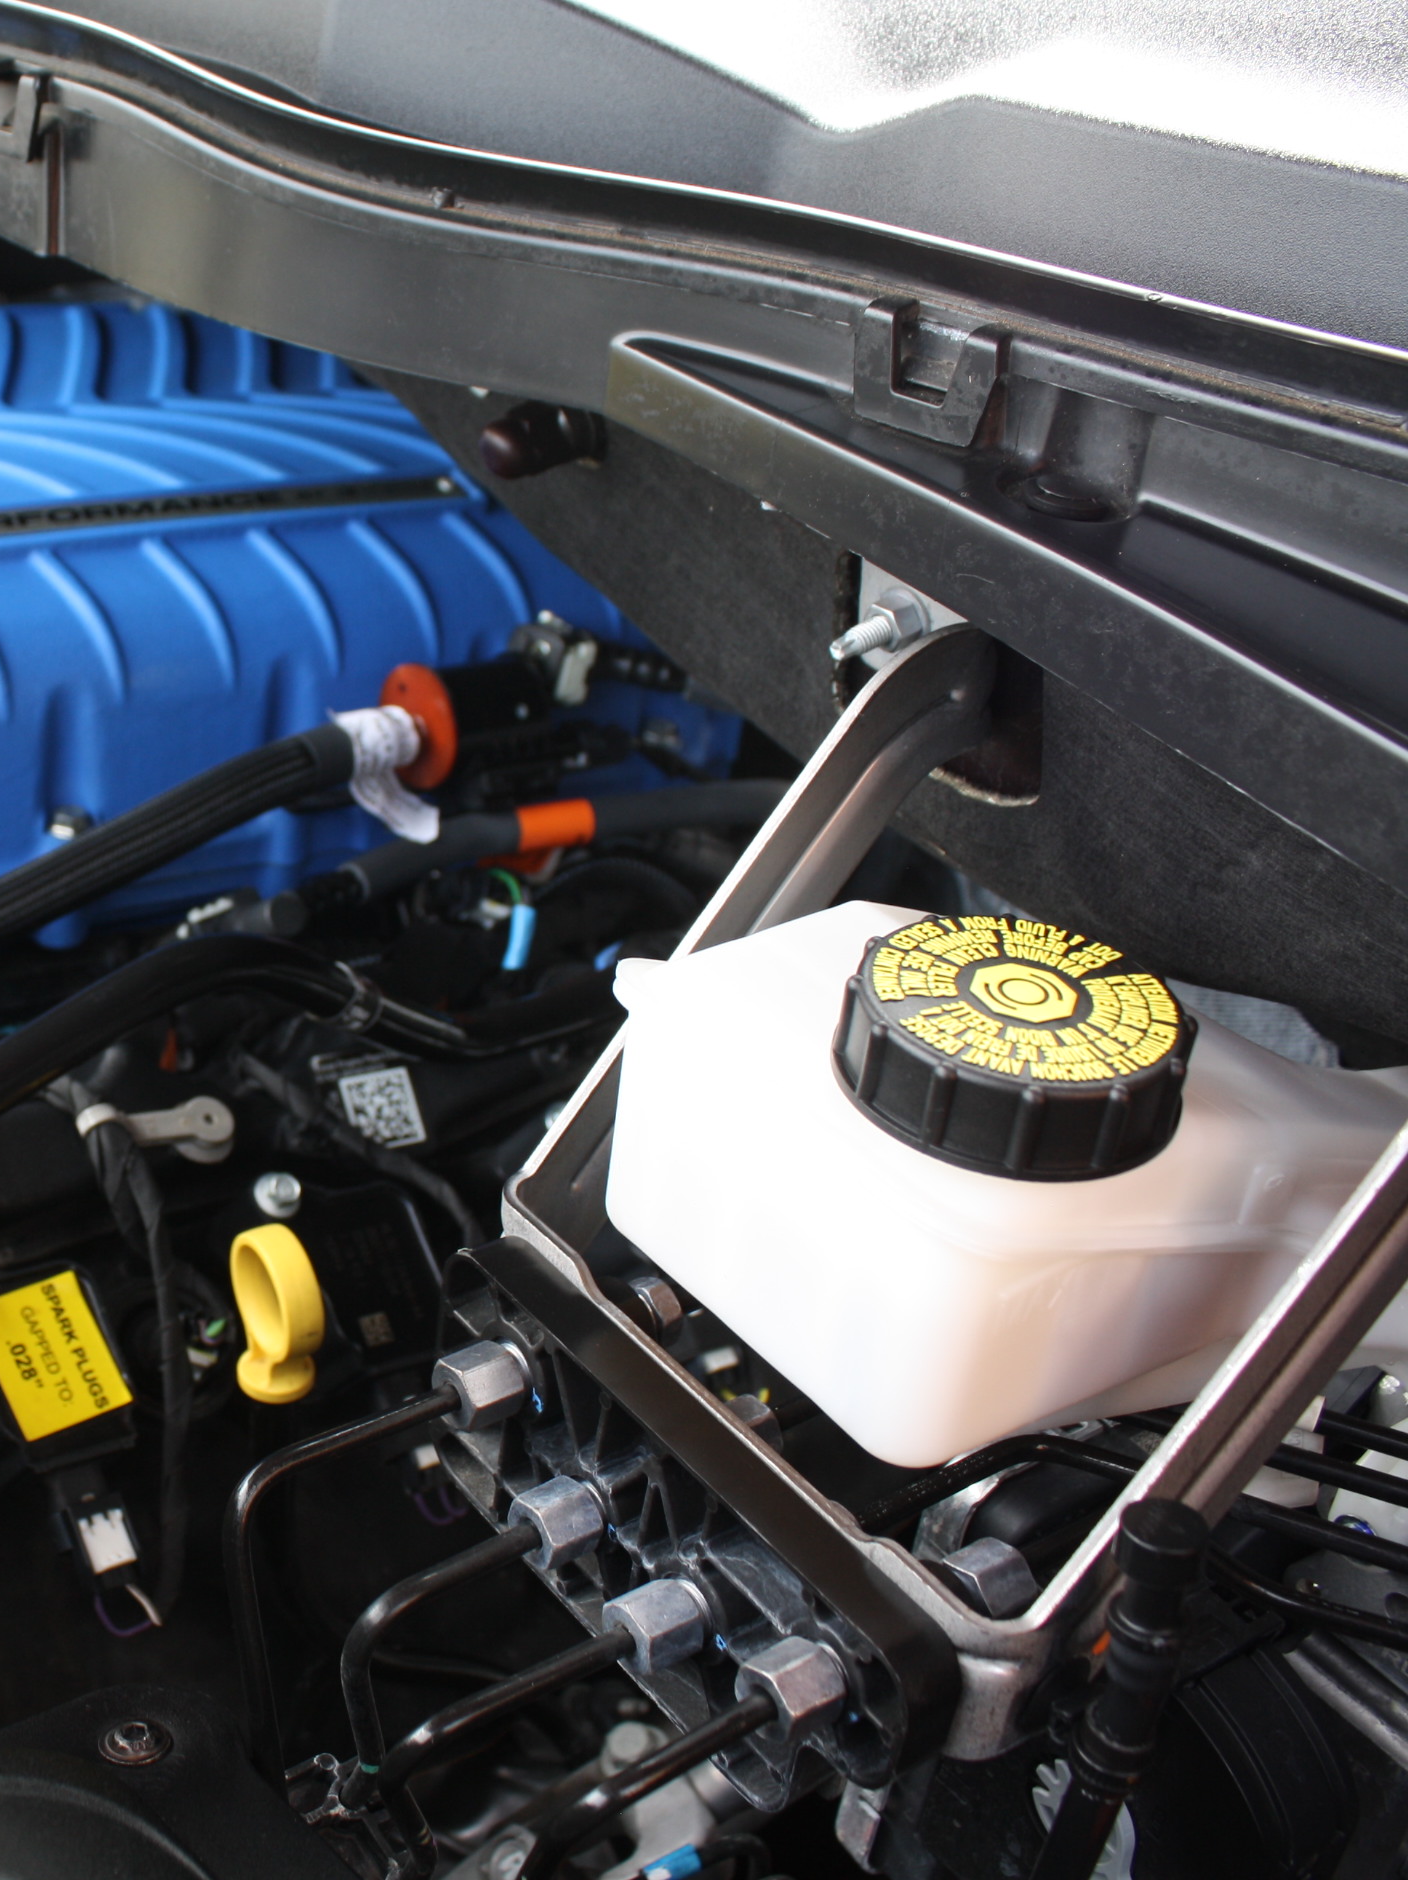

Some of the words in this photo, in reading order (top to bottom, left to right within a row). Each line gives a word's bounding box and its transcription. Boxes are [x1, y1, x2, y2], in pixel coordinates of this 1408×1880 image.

[888, 921, 944, 950] SEALED
[938, 918, 958, 932] A
[958, 916, 1009, 930] FROM
[1015, 919, 1067, 941] FLUID
[919, 929, 998, 955] REMOVING
[942, 943, 999, 966] CLEAN
[1001, 929, 1069, 955] BEFORE
[1082, 942, 1123, 962] DOT
[901, 950, 935, 972] USE
[1003, 943, 1090, 978] WARNING
[1068, 951, 1106, 969] CAP
[872, 946, 905, 1002] CONTAINER
[900, 970, 932, 997] ONLY
[927, 960, 960, 998] FILLER
[1127, 973, 1178, 1024] ATTENTION
[929, 1014, 968, 1036] DOT
[941, 1000, 1004, 1036] SCELLE
[899, 1014, 965, 1055] DEPOSE
[961, 1028, 1013, 1056] FREIN
[1004, 1025, 1058, 1047] BIDON
[960, 1047, 1025, 1077] AVANT
[1015, 1042, 1038, 1062] DE
[1040, 1043, 1106, 1063] LIQUIDE
[1105, 1054, 1139, 1076] LE
[1029, 1060, 1116, 1081] BOUCHON
[20, 1306, 61, 1375] GAPPED
[41, 1283, 79, 1345] SPARK
[71, 1347, 110, 1409] PLUGS
